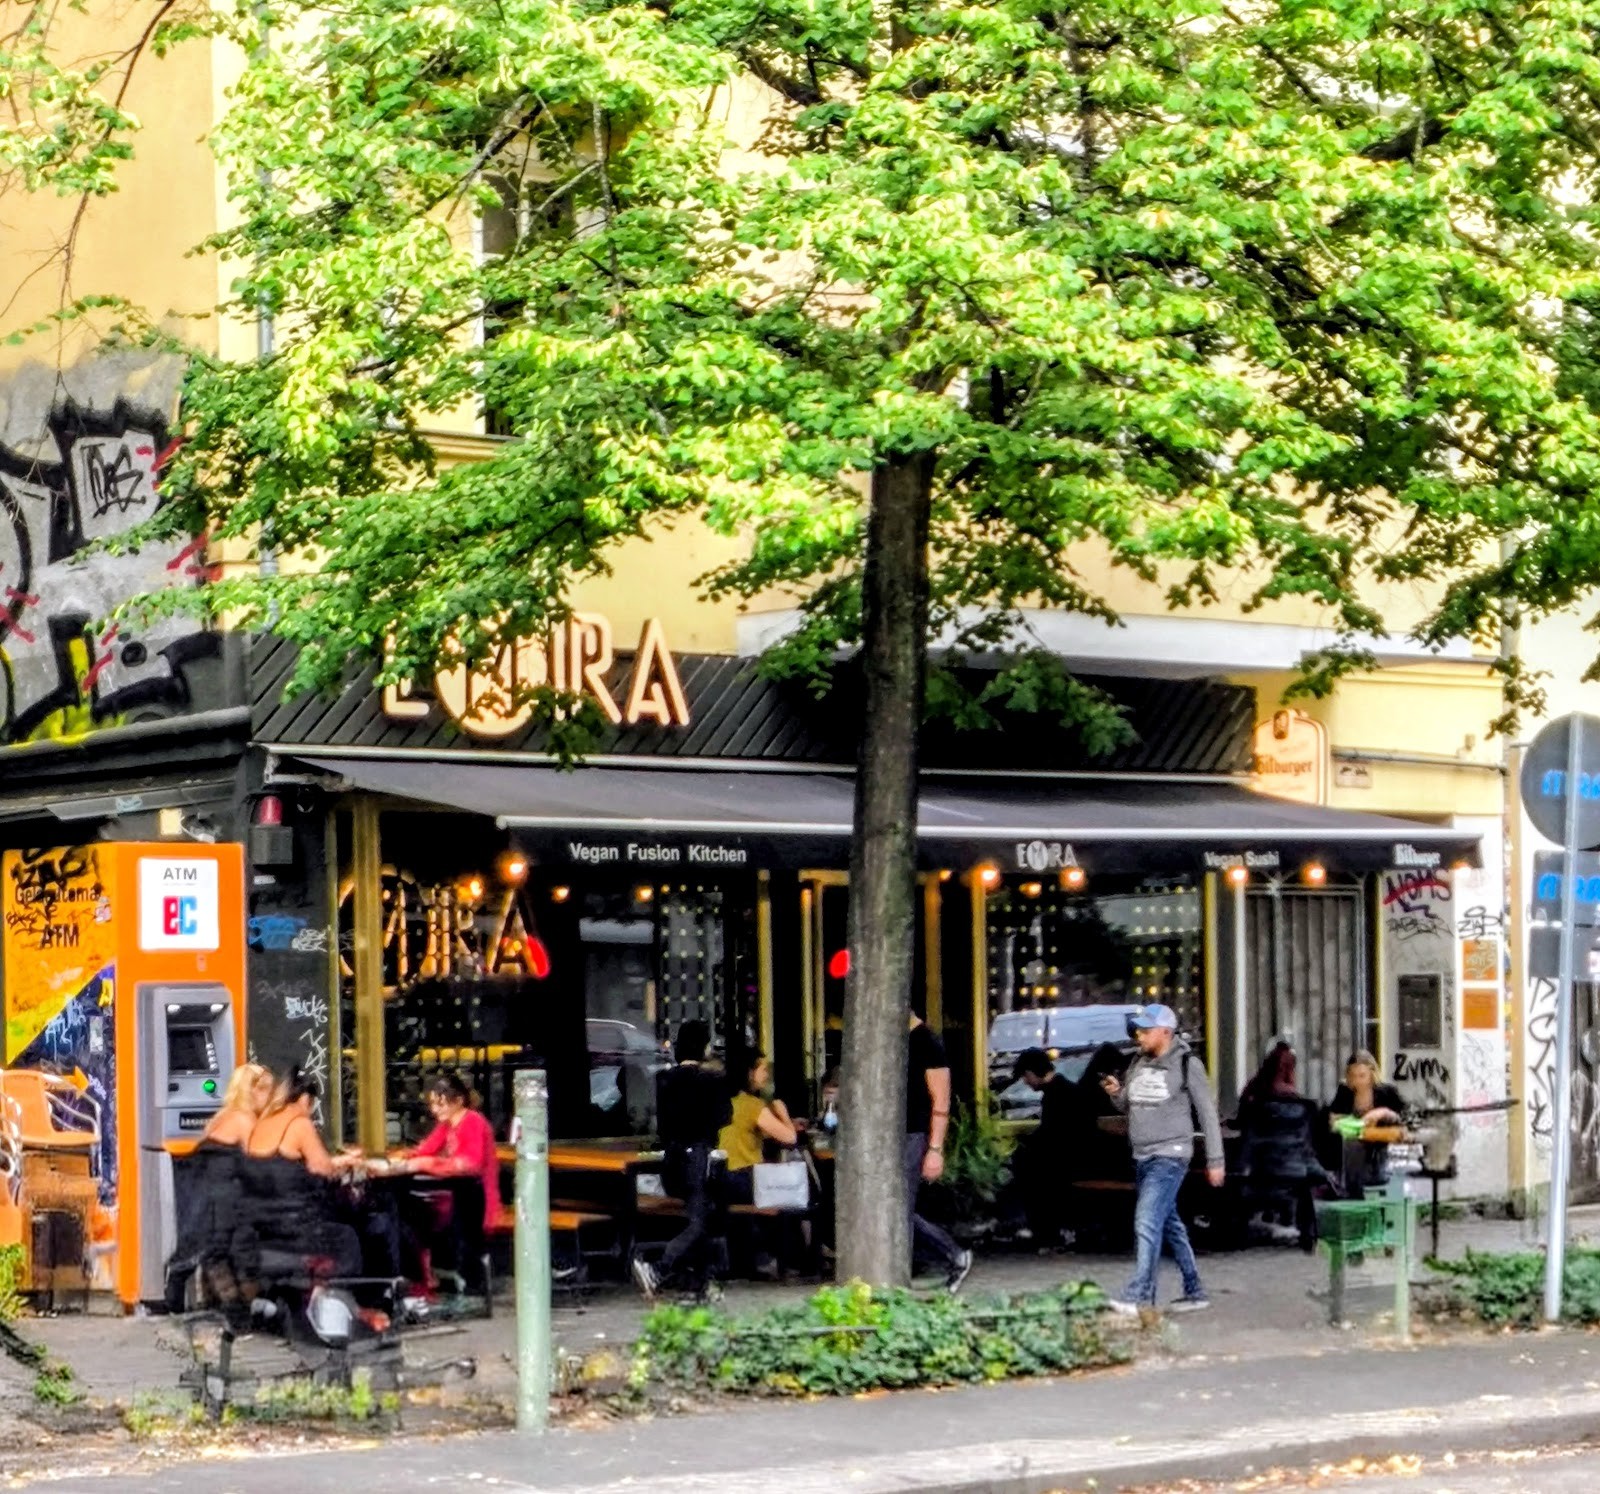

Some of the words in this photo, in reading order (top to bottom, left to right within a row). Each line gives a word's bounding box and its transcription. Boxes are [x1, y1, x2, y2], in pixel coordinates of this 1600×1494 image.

[569, 842, 619, 863] Vegan
[627, 843, 680, 861] Fusion
[689, 844, 747, 863] Kitchen
[1204, 851, 1244, 870] Vegan
[1245, 850, 1280, 867] Sushi
[162, 867, 198, 881] ATM
[41, 922, 80, 950] ATM
